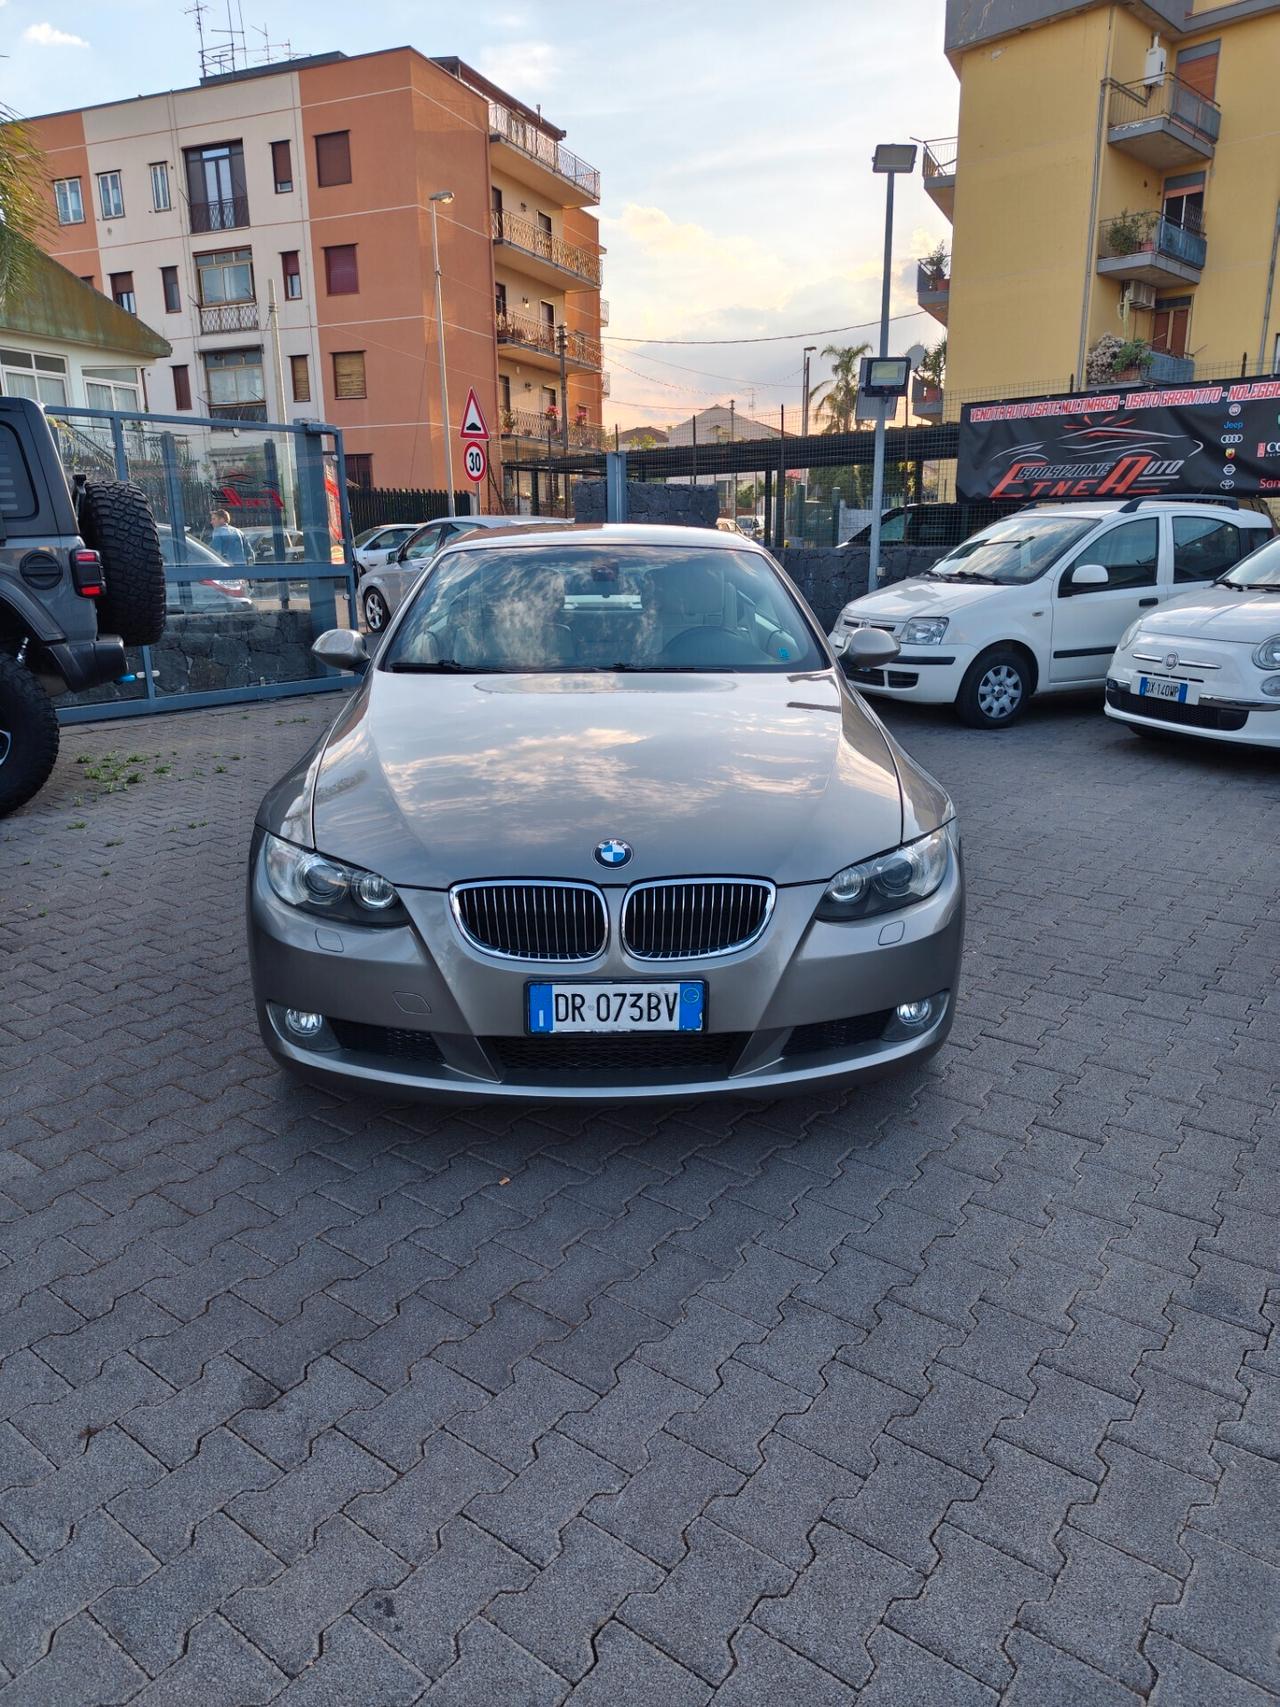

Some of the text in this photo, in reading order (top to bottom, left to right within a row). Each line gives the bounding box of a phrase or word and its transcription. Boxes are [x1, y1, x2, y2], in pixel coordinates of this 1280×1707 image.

[970, 406, 1006, 423] VENDITA
[1005, 404, 1030, 420] AUTO
[1060, 395, 1120, 414] MULTIMARCA
[1124, 391, 1161, 410] USATO
[1159, 386, 1223, 407] GARANTITO
[1223, 421, 1244, 430] Jeep
[469, 452, 481, 472] 30
[1096, 456, 1185, 494] AUTO
[554, 993, 586, 1023] DR
[596, 993, 678, 1023] 073BV
